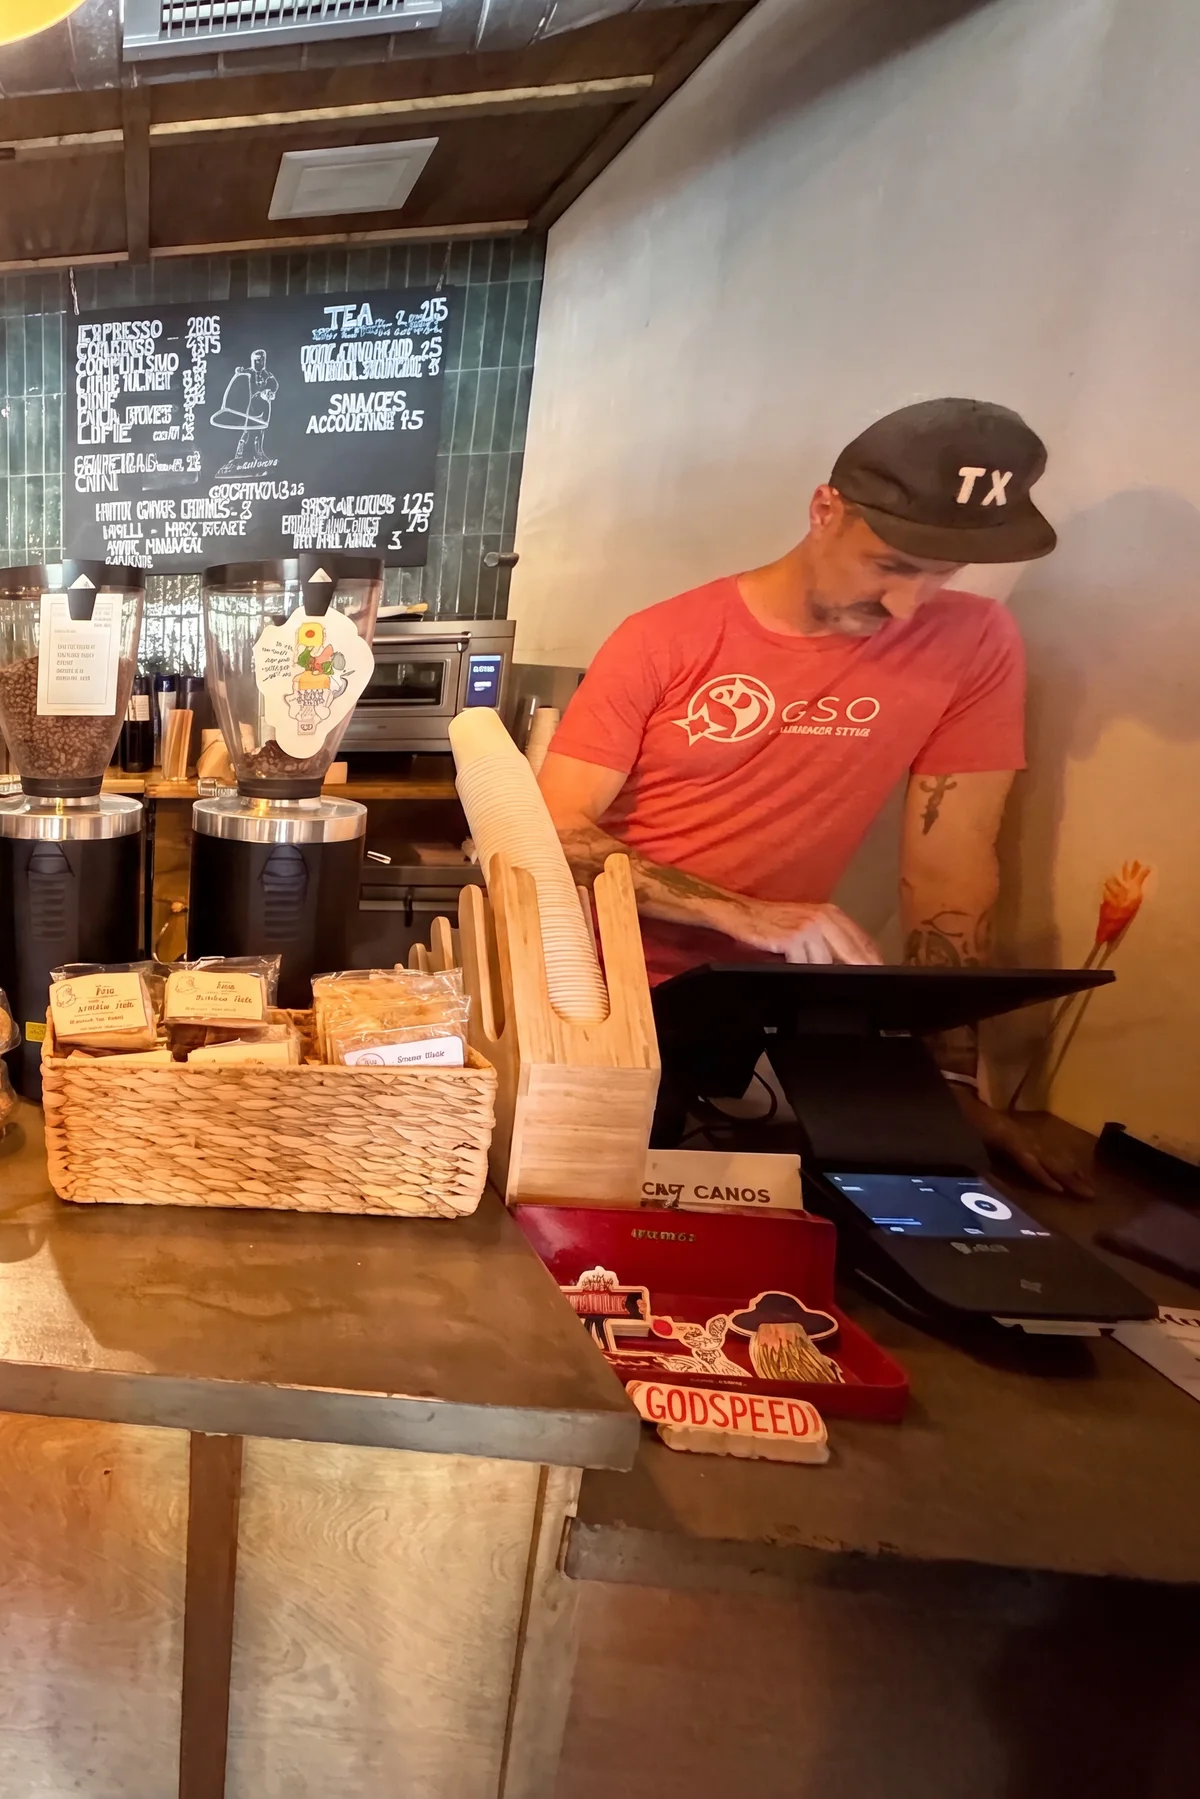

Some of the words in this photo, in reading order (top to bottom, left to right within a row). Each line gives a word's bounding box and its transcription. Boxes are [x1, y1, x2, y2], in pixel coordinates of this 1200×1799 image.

[324, 303, 374, 330] TEA
[956, 466, 1013, 506] TX
[781, 696, 881, 723] GSO
[694, 1185, 771, 1203] CANOS
[646, 1386, 809, 1437] GODSPEED
